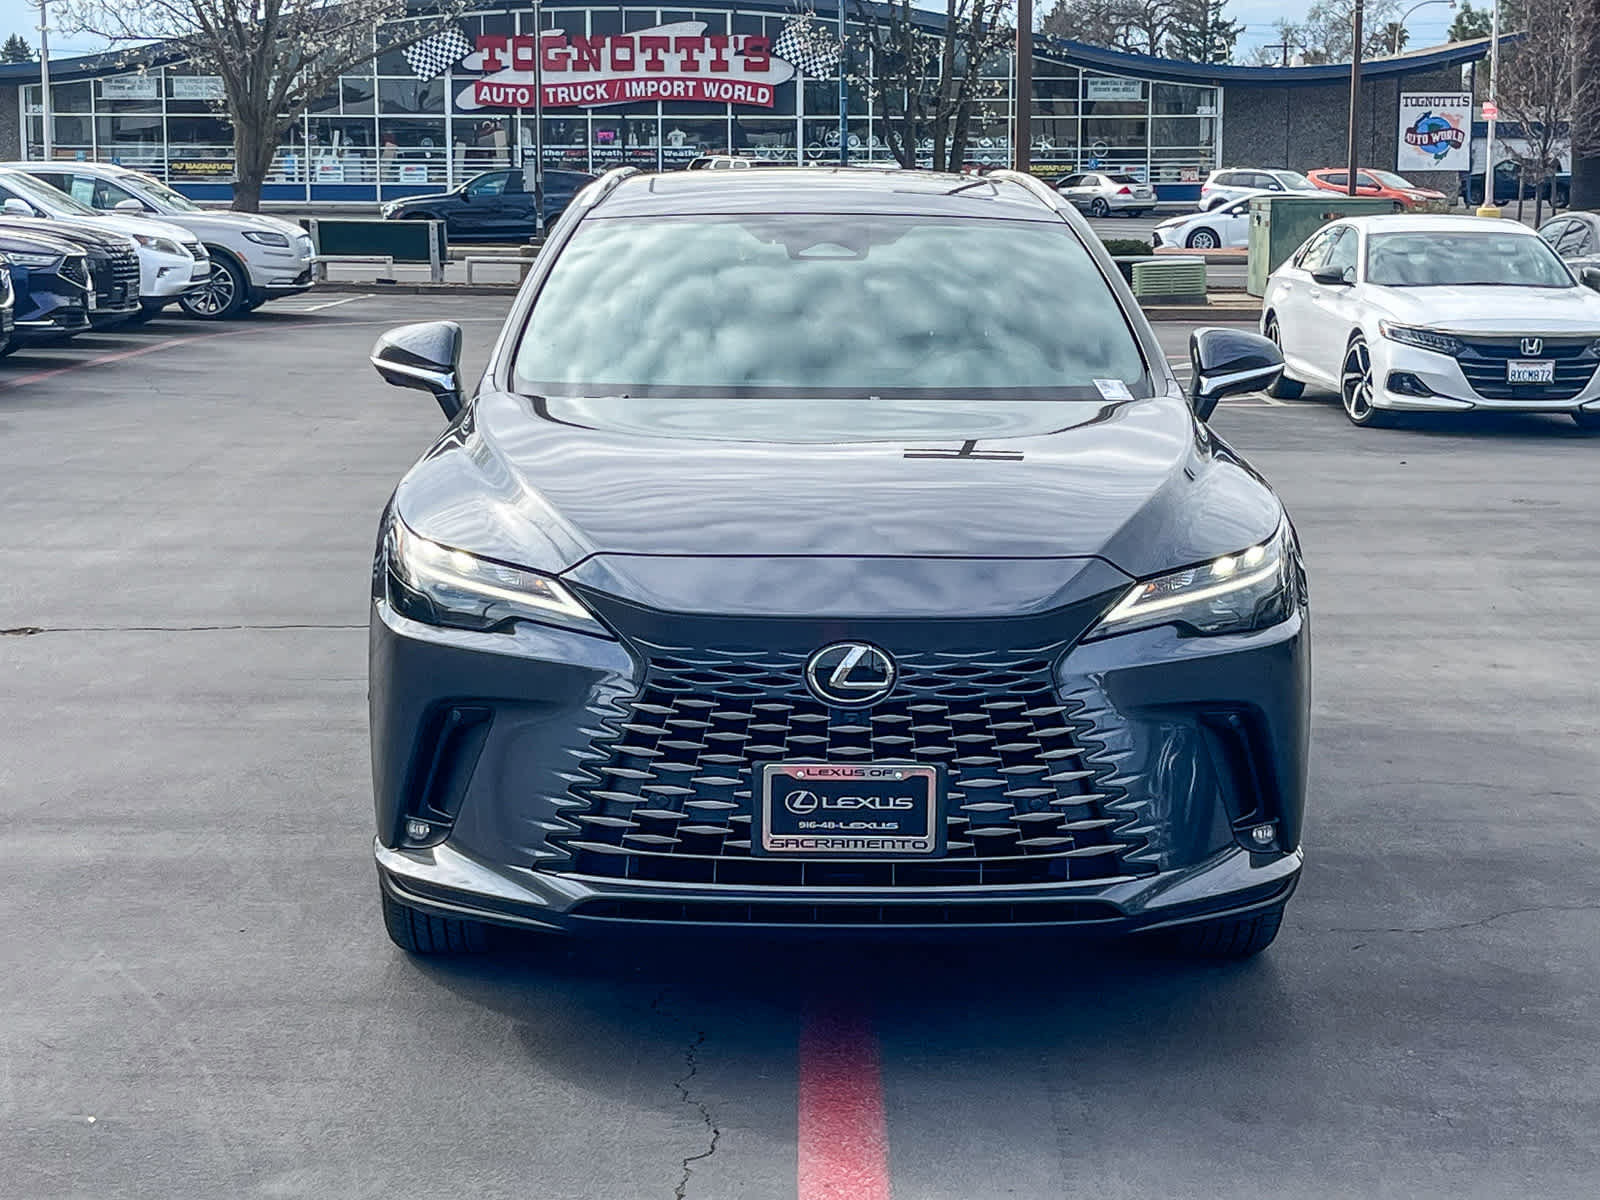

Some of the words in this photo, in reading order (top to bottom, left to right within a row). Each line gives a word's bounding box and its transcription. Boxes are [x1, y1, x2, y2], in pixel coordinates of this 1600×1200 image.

[476, 35, 770, 72] TOGNOTTI'S
[479, 85, 531, 104] AUTO
[545, 83, 609, 103] TRUCK
[624, 80, 697, 98] IMPORT
[702, 81, 770, 104] WORLD
[1402, 95, 1470, 107] TOGNOTTI'S
[1406, 132, 1429, 145] AUTO
[1430, 128, 1464, 142] WORLD
[806, 768, 866, 777] LEXUS
[869, 769, 894, 777] OF
[821, 796, 914, 810] LEXUS
[769, 838, 929, 850] SACRAMENTO
